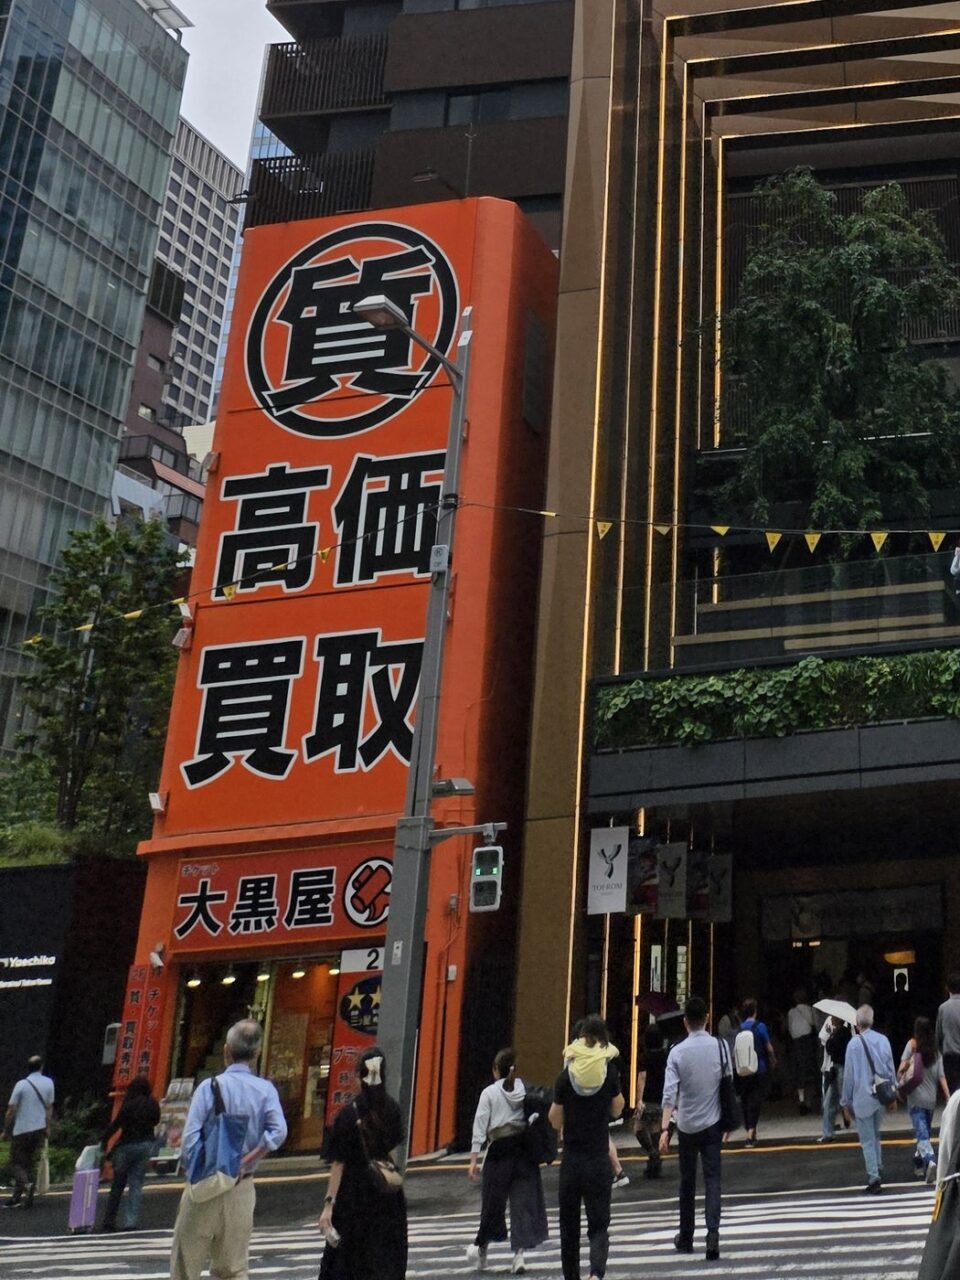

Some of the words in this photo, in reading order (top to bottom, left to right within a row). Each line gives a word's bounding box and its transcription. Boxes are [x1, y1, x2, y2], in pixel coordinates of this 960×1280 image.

[261, 245, 436, 417] 質
[212, 450, 446, 601] 高価
[180, 628, 426, 790] 買取
[9, 955, 56, 968] Yaechika
[175, 867, 336, 939] 大黒屋
